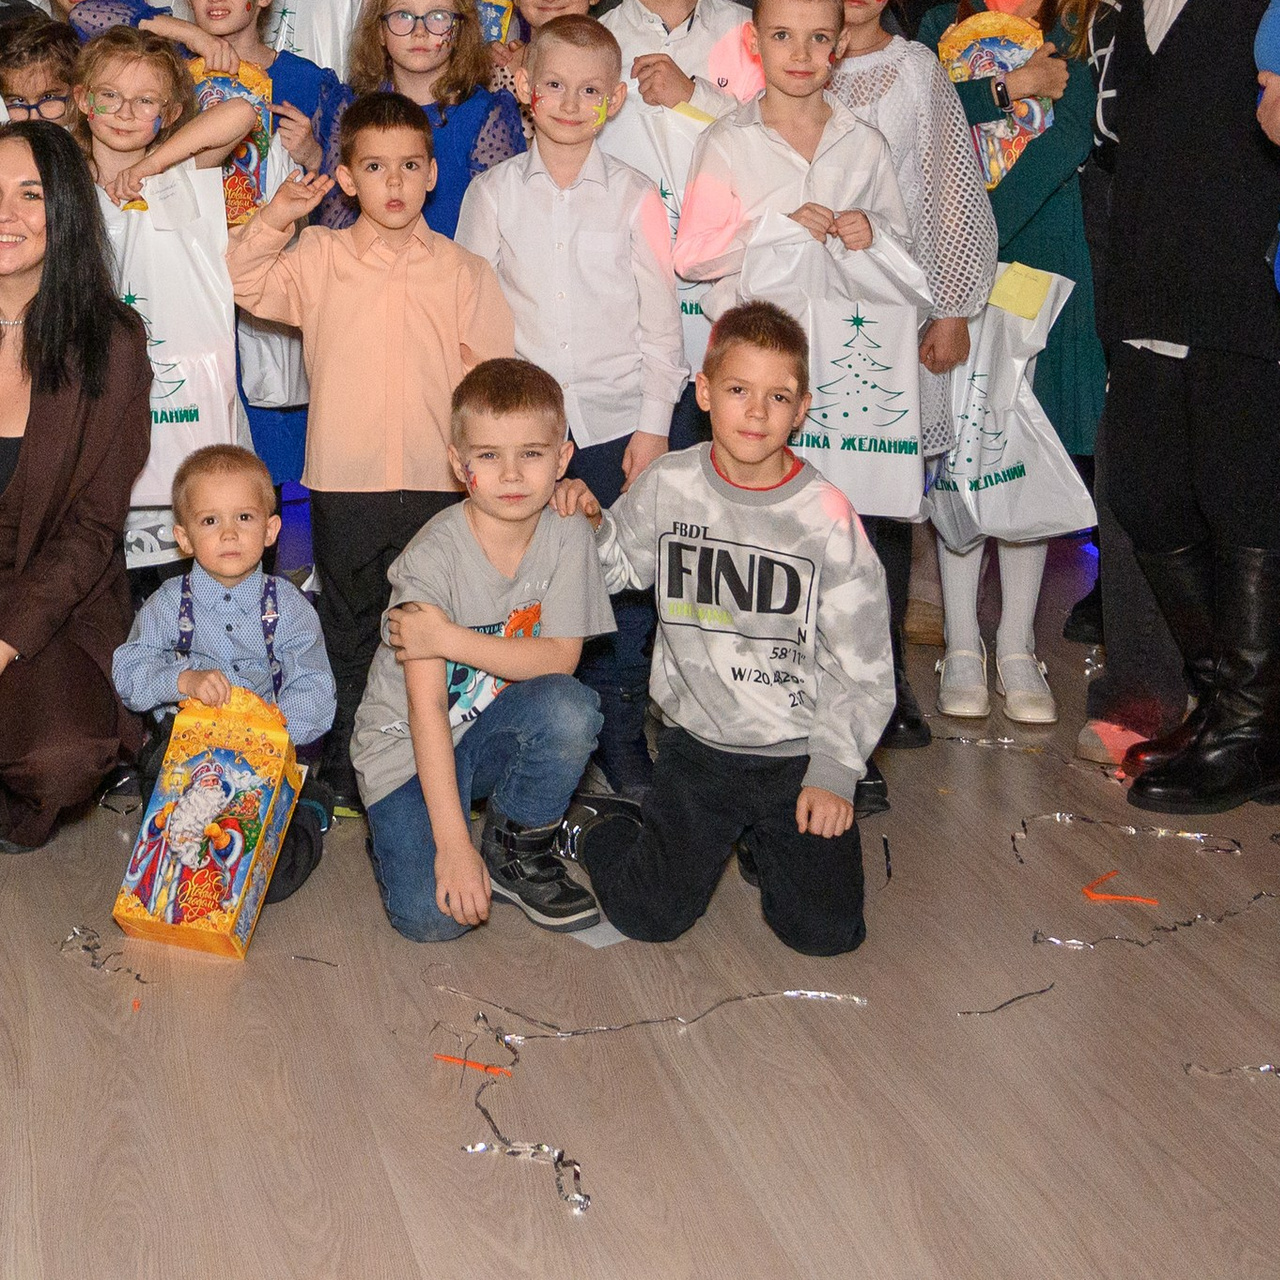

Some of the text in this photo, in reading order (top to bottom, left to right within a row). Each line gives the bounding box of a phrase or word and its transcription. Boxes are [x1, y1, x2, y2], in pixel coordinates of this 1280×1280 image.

[840, 433, 918, 455] ЖЕЛАНИЙ
[672, 520, 709, 540] FBDT
[666, 540, 802, 616] FIND
